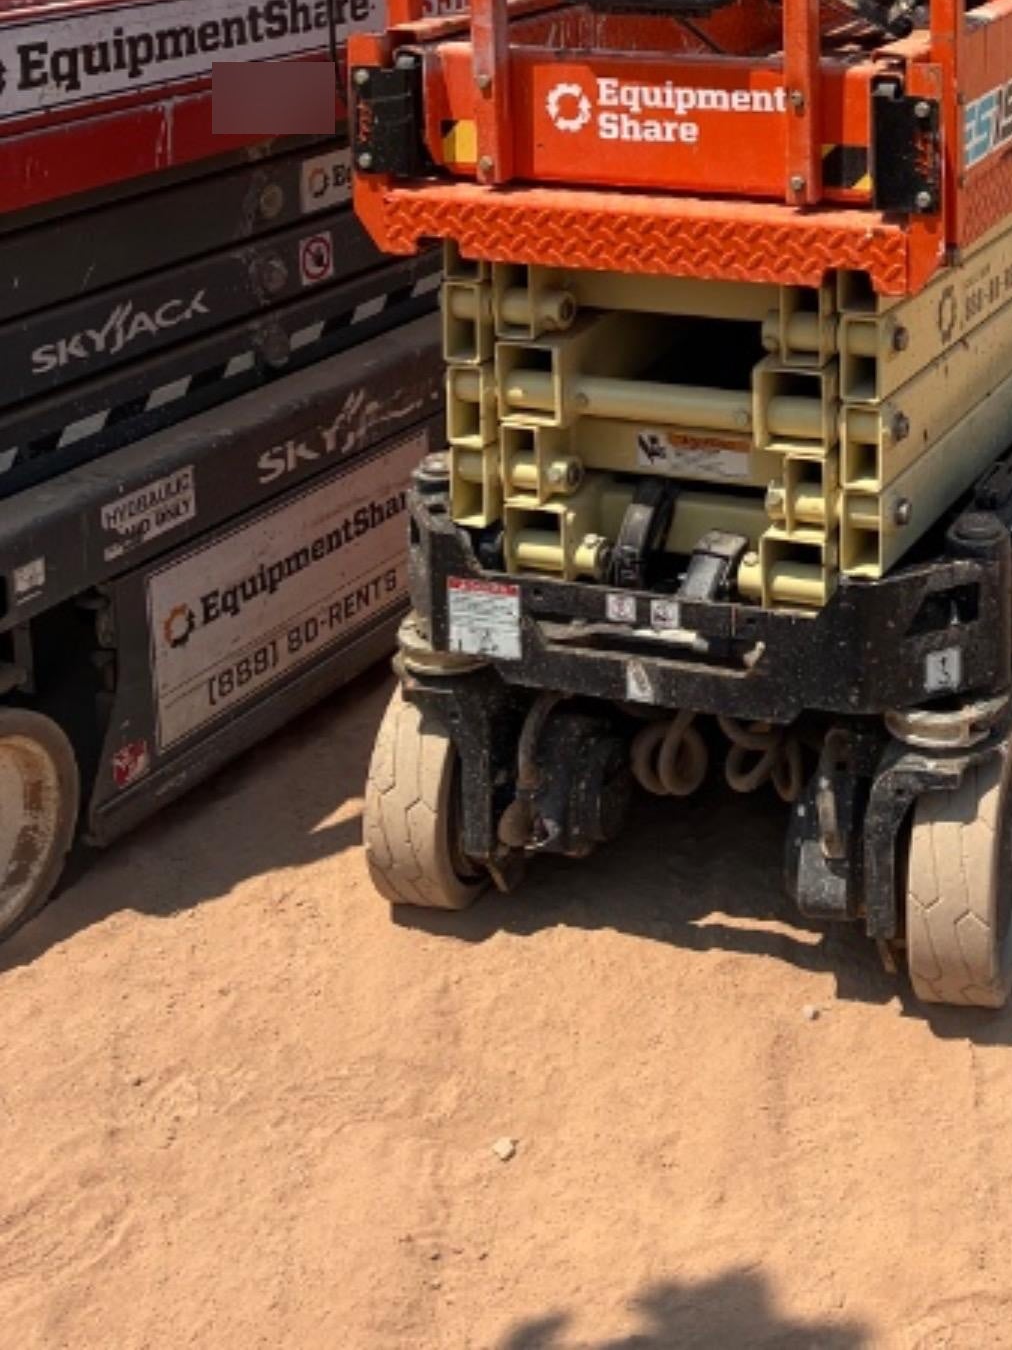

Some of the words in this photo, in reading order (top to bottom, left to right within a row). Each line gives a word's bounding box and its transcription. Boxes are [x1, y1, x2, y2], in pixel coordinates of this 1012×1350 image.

[597, 78, 786, 115] Equipment
[598, 112, 698, 142] Share
[31, 290, 211, 375] SKYJACK
